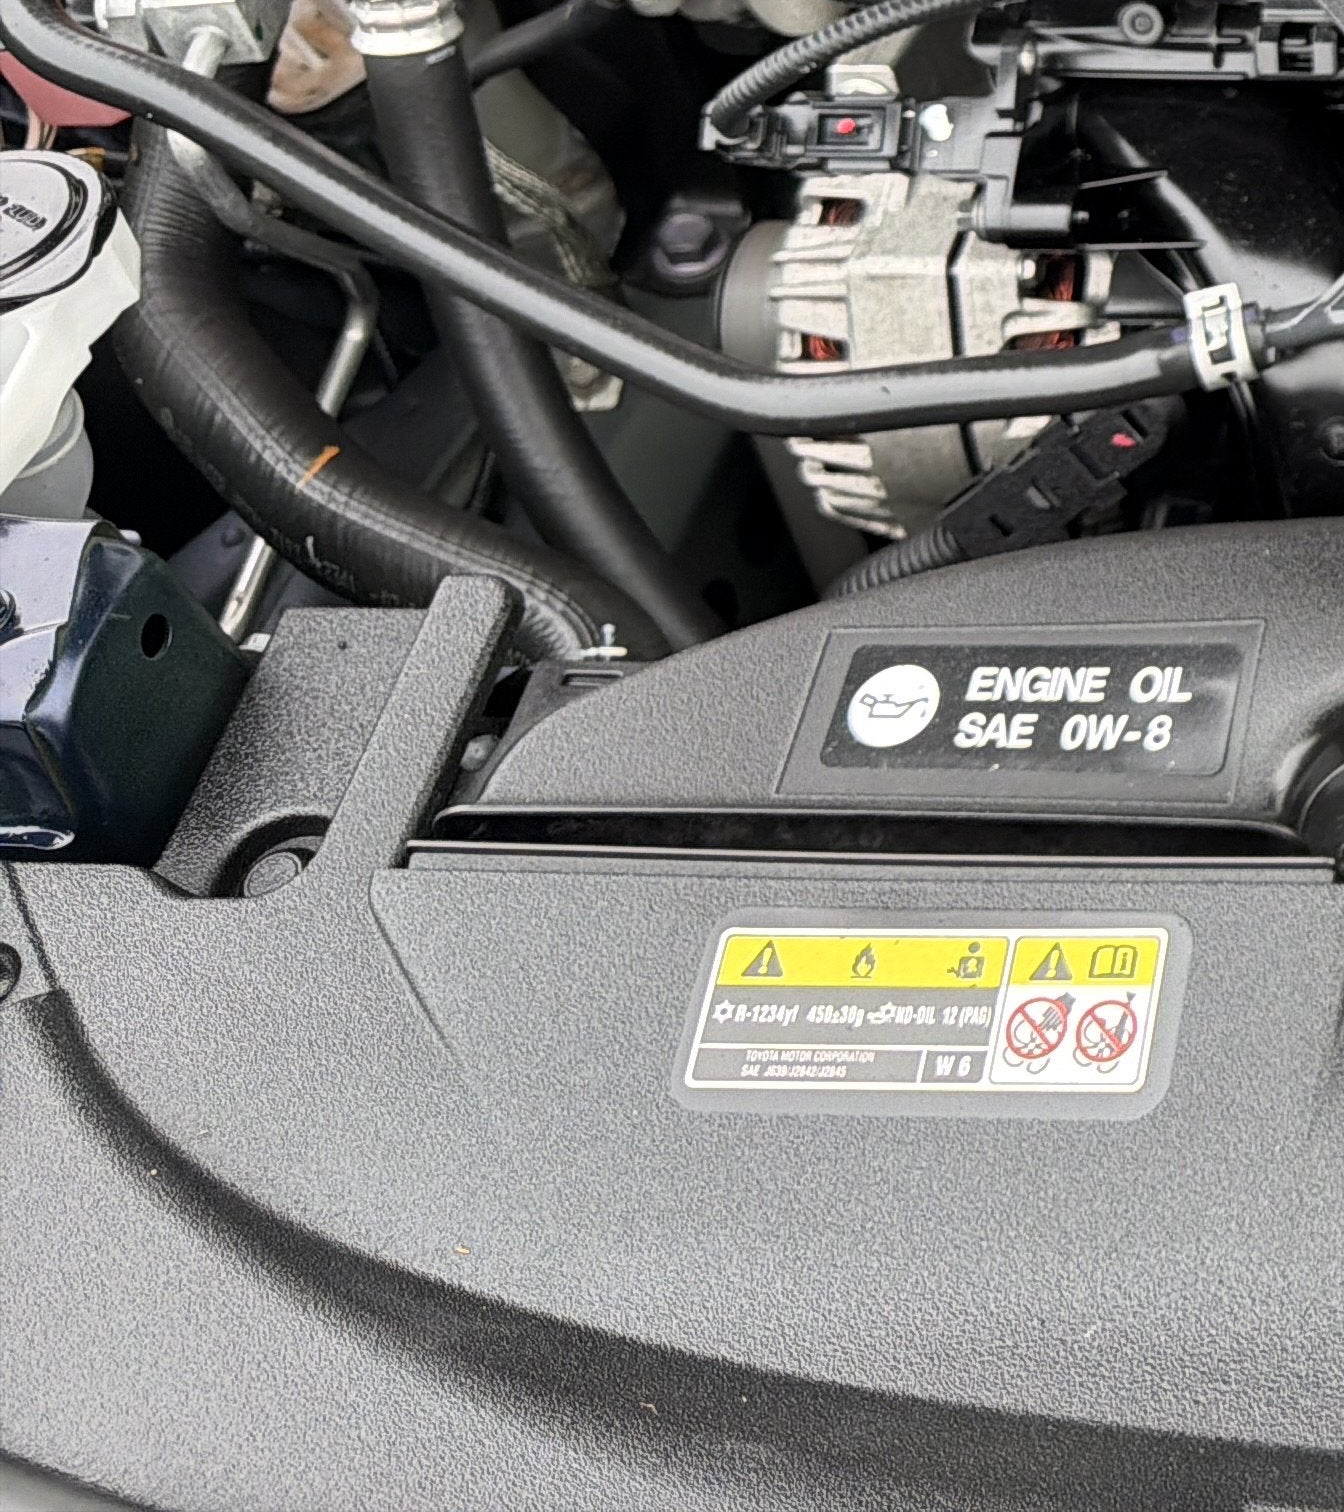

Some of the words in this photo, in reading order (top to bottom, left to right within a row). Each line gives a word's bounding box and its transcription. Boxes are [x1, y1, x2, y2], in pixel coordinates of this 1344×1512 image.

[965, 666, 1111, 702] ENGINE
[1129, 665, 1193, 703] OIL
[953, 712, 1039, 748] SAE
[1060, 713, 1173, 752] 0W-8
[745, 1050, 779, 1062] TOYOTA
[780, 1050, 812, 1063] MOTOR
[935, 1055, 957, 1076] W
[959, 1056, 972, 1076] 6
[741, 1064, 760, 1077] SAE
